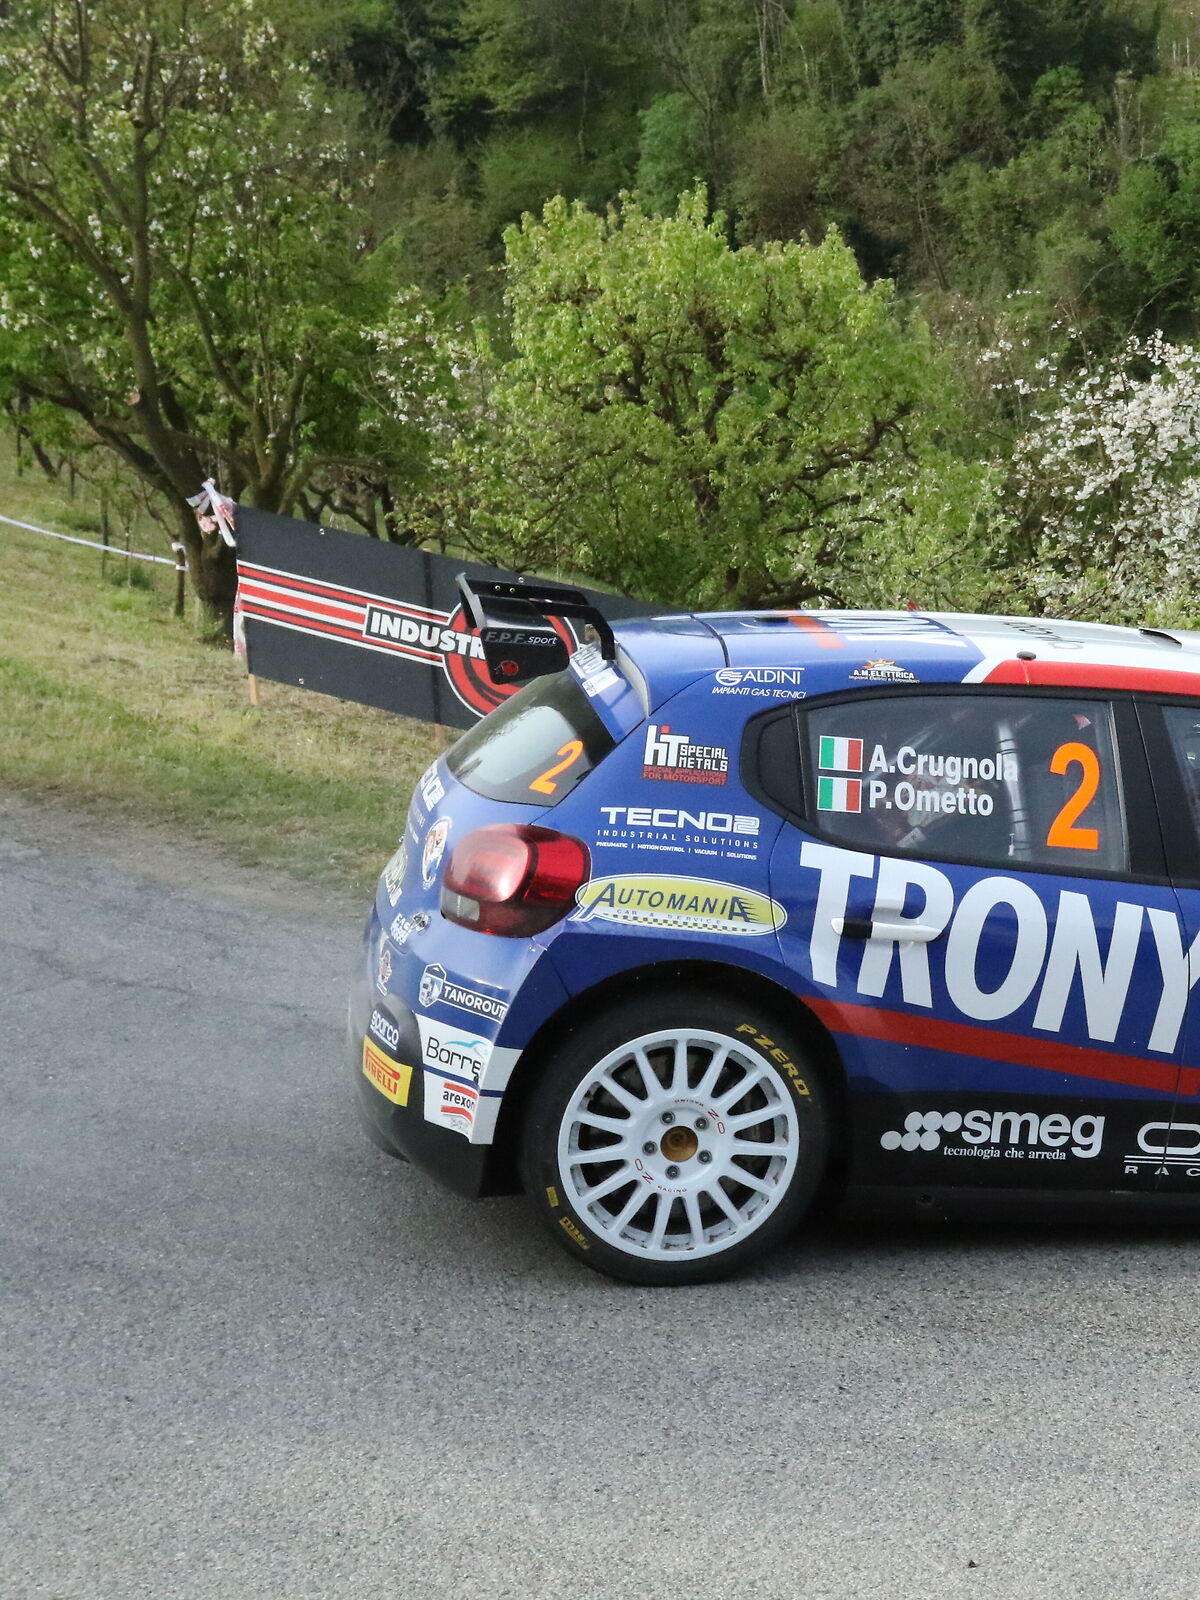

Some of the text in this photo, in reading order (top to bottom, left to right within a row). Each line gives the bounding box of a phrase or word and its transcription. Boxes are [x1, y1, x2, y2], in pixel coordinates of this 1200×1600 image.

[528, 636, 557, 645] sport
[712, 687, 806, 699] IMPIANTI GAS TECNICI
[678, 756, 728, 772] METALS
[680, 744, 728, 760] SPECIAL
[869, 744, 1018, 785] A.Crugnola
[529, 740, 584, 794] 2
[869, 780, 993, 816] P.Ometto
[1046, 742, 1100, 850] 2
[600, 806, 761, 836] TECNO2
[595, 841, 628, 849] PNEUMATIC
[659, 845, 685, 853] CONTROL
[694, 848, 718, 856] VACUUM
[726, 851, 757, 860] SOLUTIONS
[597, 829, 759, 849] INDUSTRIAL SOLUTIONS
[667, 914, 722, 925] SERVICE
[371, 1010, 399, 1045] sparco
[365, 1046, 400, 1095] PIRELLI
[961, 1109, 1106, 1159] smeg
[943, 1144, 1067, 1161] tecnologia che arreda
